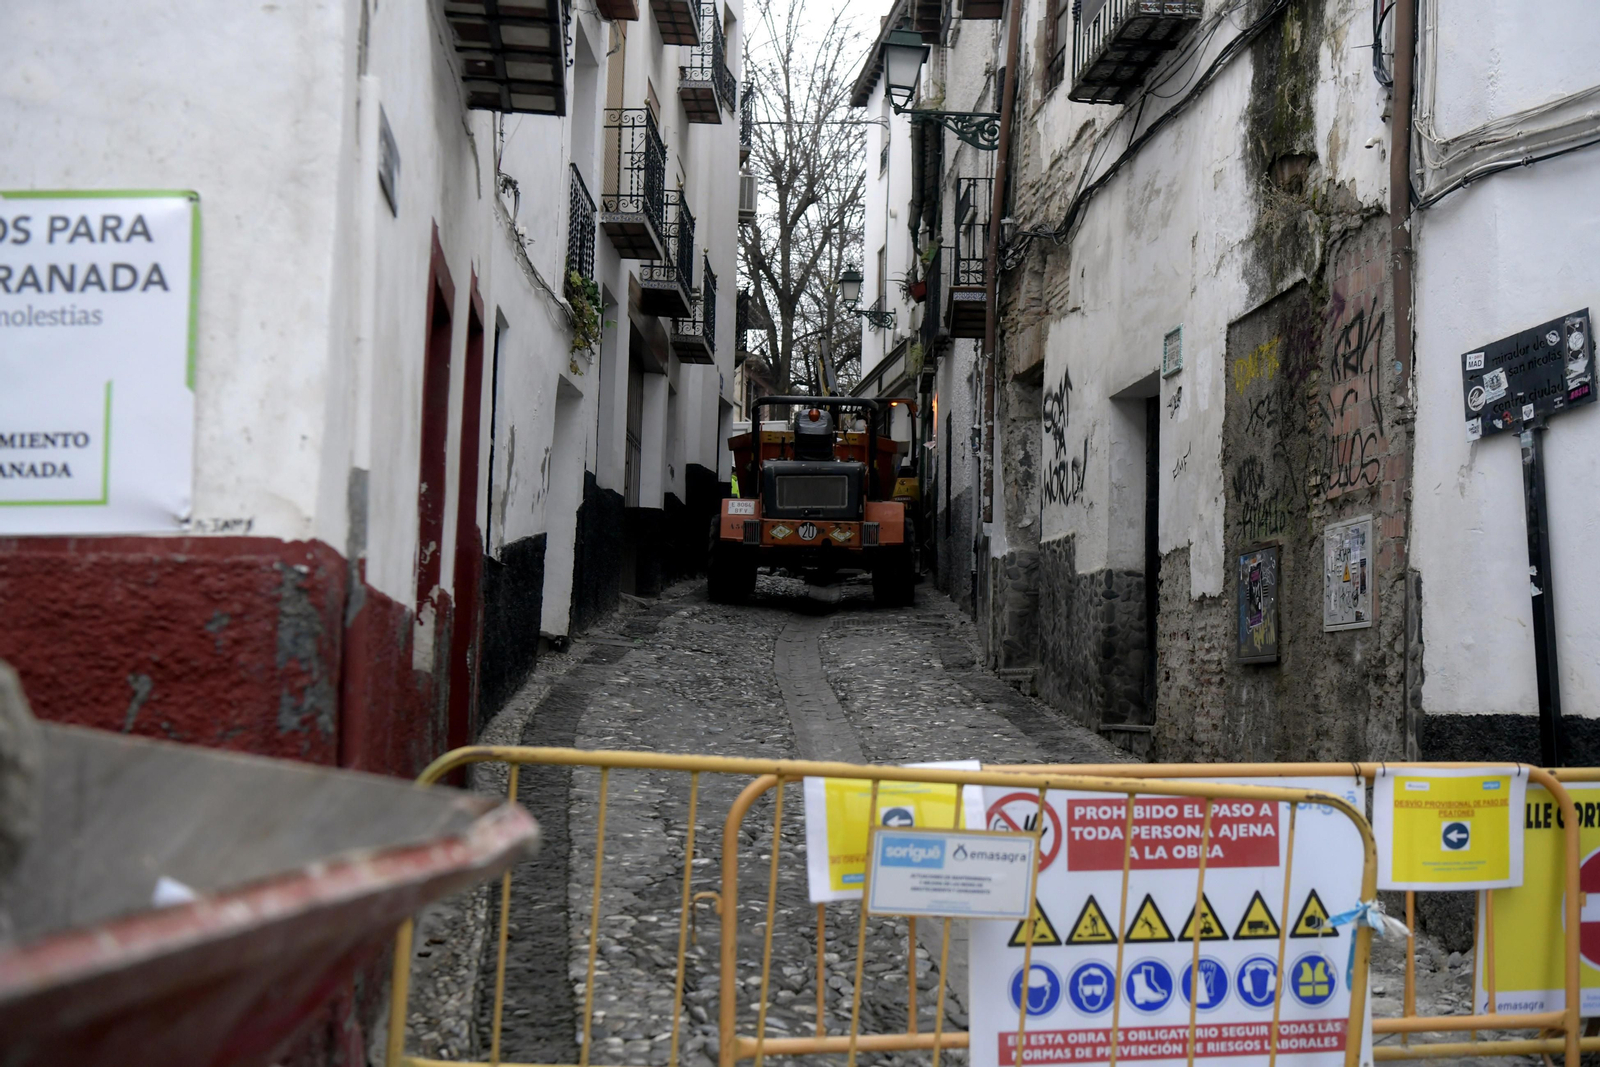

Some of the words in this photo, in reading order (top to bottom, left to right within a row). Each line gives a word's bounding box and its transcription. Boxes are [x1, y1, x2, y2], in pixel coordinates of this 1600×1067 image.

[0, 215, 31, 245] S
[48, 214, 154, 244] PARA
[1492, 342, 1529, 366] mirador
[1532, 335, 1545, 351] de
[1468, 360, 1482, 368] MAD
[1508, 363, 1525, 377] san
[1527, 348, 1563, 370] nicolás
[1493, 392, 1526, 413] centro
[1529, 374, 1564, 401] ciudad
[0, 431, 90, 448] MIENTO
[802, 524, 815, 538] 20
[1074, 804, 1179, 820] PROHBIDO
[1183, 804, 1204, 818] EL
[1210, 803, 1254, 818] PASO
[1259, 803, 1273, 817] A
[1394, 799, 1423, 808] DESVÍO
[1425, 800, 1472, 808] PROVISIONAL
[1500, 798, 1509, 806] DE
[1438, 809, 1475, 817] PEATONES
[1556, 802, 1600, 829] COR
[1070, 826, 1124, 840] TODA
[1130, 824, 1214, 840] PERSONA
[1219, 823, 1276, 841] AJENA
[970, 850, 1027, 864] emasagra
[1144, 845, 1169, 860] LA
[1497, 1001, 1545, 1012] emasagra
[1030, 1033, 1064, 1046] ESTA
[1067, 1032, 1106, 1044] OBRA
[1221, 1025, 1269, 1038] SEGUIR
[1275, 1023, 1315, 1035] ODAS
[1318, 1021, 1342, 1034] LAS
[1075, 1047, 1093, 1059] DE
[1096, 1041, 1183, 1058] PREVENCIÓN
[1206, 1040, 1261, 1053] RIESGOS
